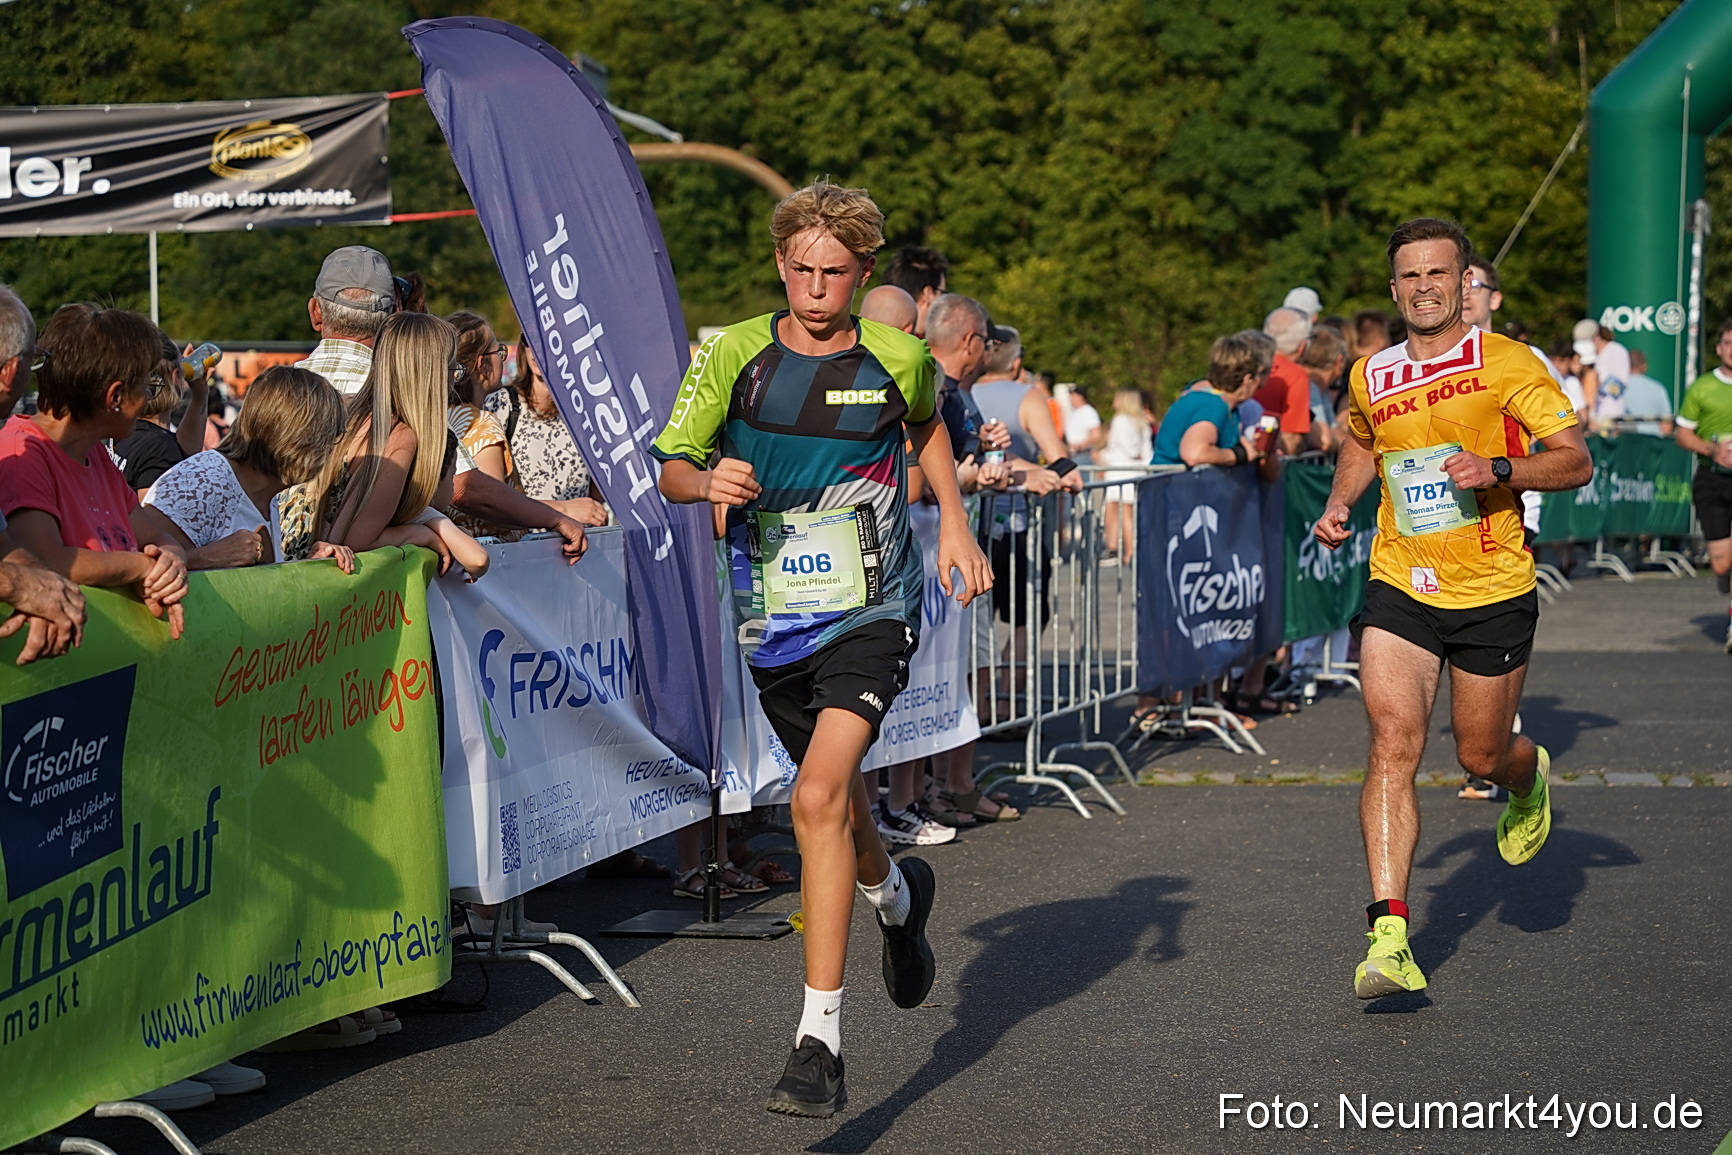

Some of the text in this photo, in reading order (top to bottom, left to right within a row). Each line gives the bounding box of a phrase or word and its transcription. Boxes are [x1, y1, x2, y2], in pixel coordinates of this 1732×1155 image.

[173, 187, 357, 209] Ein Ort, der verbindet.
[825, 389, 889, 405] BOCK
[1372, 377, 1488, 428] MAX BÖGL
[1404, 481, 1447, 503] 1787
[1406, 506, 1434, 515] Thomas
[781, 553, 832, 575] 406
[786, 576, 842, 588] Jona Pfindel
[868, 569, 876, 599] HILTL
[214, 589, 412, 708] Gesunde Firmen
[858, 691, 885, 713] JAKO
[259, 685, 334, 769] laufen
[883, 720, 920, 747] MORGEN
[23, 735, 109, 790] Fischer
[626, 757, 674, 784] HEUTE
[30, 767, 99, 808] AUTOMOBILE
[629, 786, 675, 822] MORGEN
[4, 971, 79, 1045] markt
